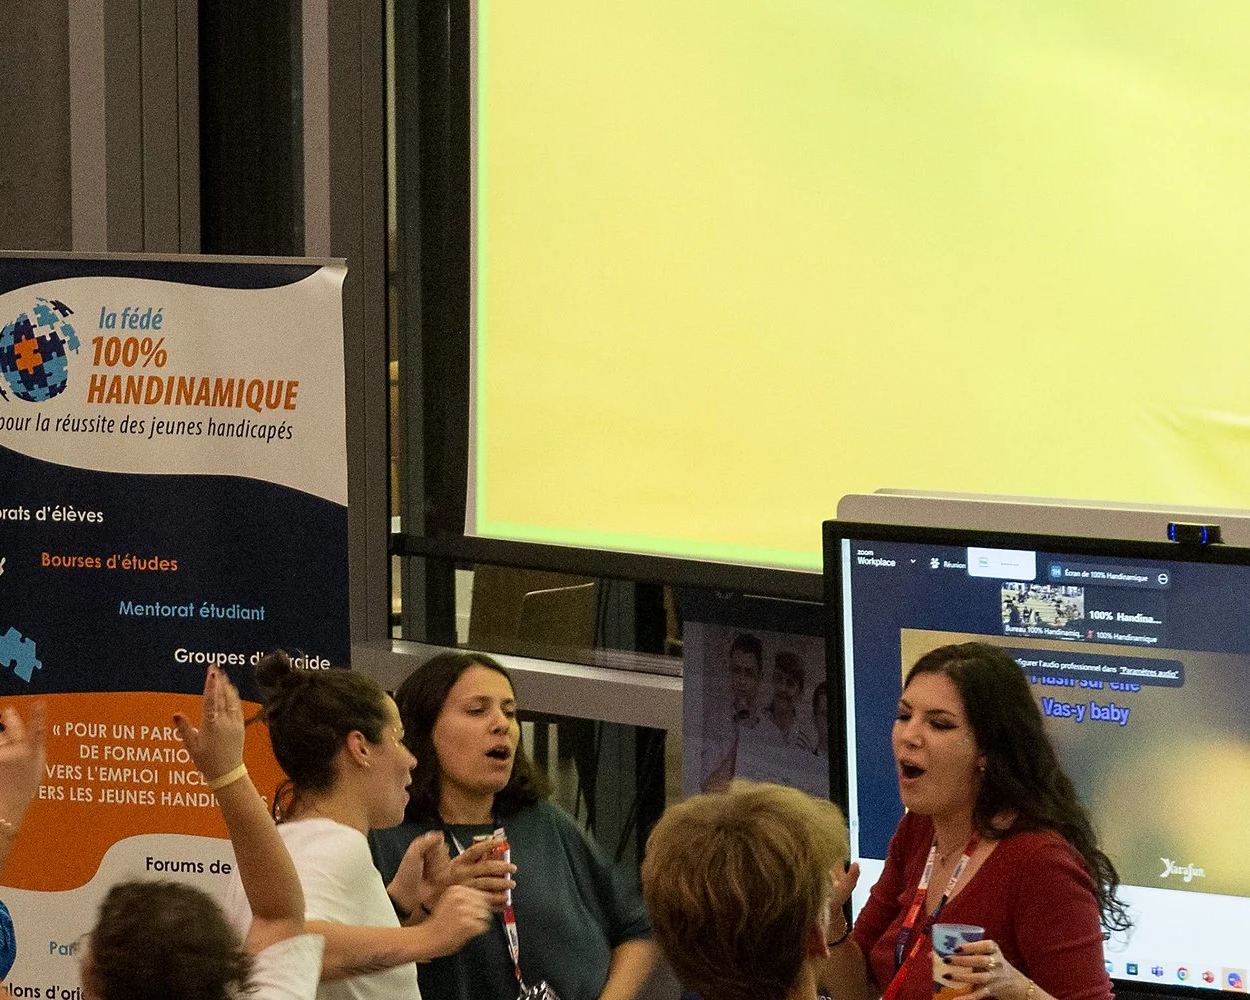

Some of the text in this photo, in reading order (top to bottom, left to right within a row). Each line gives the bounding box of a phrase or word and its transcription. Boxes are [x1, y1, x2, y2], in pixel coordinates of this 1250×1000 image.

[99, 306, 164, 330] la fédé
[91, 335, 168, 368] 100%
[86, 373, 299, 413] HANDINAMIQUE
[36, 413, 51, 431] la
[55, 414, 115, 433] réussite
[120, 416, 145, 434] des
[147, 417, 202, 439] jeunes
[207, 417, 293, 443] handicapés
[35, 506, 104, 523] d'élèves
[41, 552, 178, 571] Bourses d'études
[857, 556, 967, 569] Workplace Réunion
[1090, 571, 1106, 579] 100%
[1106, 572, 1149, 583] Handinamique
[119, 600, 265, 621] Mentorat étudiant
[1089, 610, 1113, 620] 100%
[1005, 625, 1027, 633] Bureau
[1027, 626, 1044, 635] 100%
[1096, 631, 1158, 644] 100% Handinamique
[174, 648, 246, 667] Groupes
[1060, 662, 1101, 672] professionnel
[1102, 665, 1117, 673] dans
[1041, 697, 1130, 727] Vas-y baby
[65, 722, 107, 738] POUR
[112, 725, 135, 739] UN
[80, 745, 192, 764] DE FORMATIO
[46, 765, 82, 781] VERS
[87, 766, 159, 784] L'EMPLOI
[70, 787, 93, 802] LES
[98, 788, 155, 806] JEUNES
[146, 857, 232, 875] Forums de
